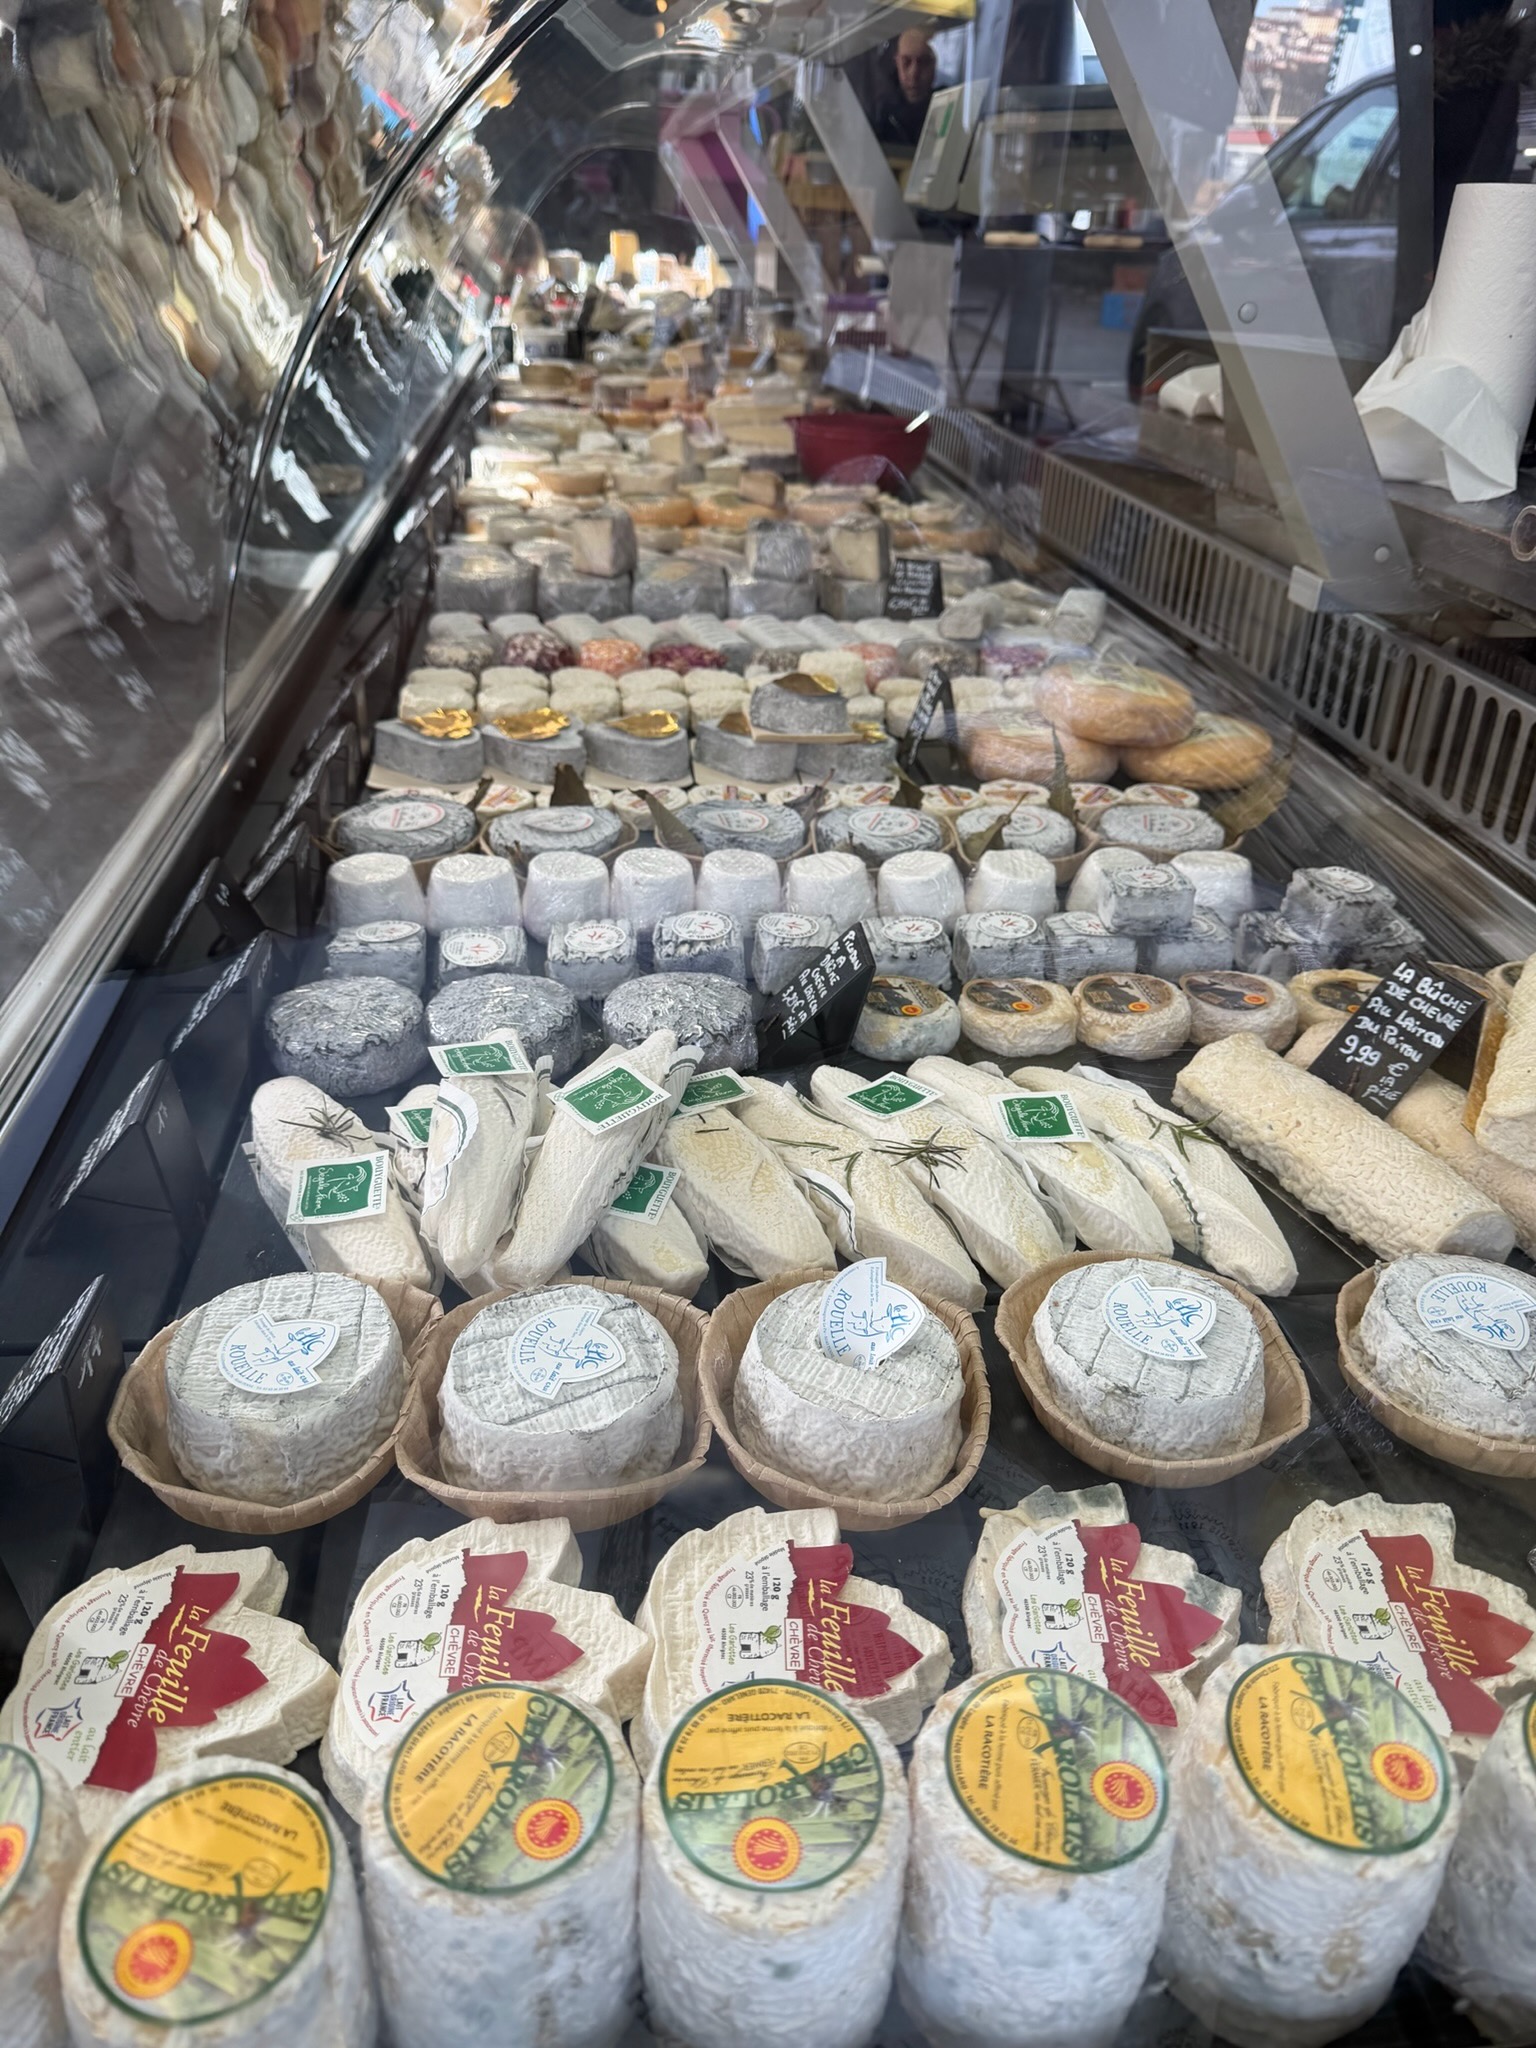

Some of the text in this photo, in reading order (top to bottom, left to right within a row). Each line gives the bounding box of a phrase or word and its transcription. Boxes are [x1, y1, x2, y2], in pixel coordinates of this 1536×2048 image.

[1384, 981, 1407, 999] DE
[1392, 962, 1473, 1015] LA BÛCHE
[1338, 1034, 1383, 1067] 9,99
[1431, 1281, 1488, 1303] ROUELLE
[520, 1318, 557, 1365] ROUELLE
[830, 1289, 852, 1357] ROUELLE
[1113, 1302, 1153, 1345] ROUELLE
[229, 1344, 268, 1384] ROUELLE
[1053, 1546, 1065, 1585] l'emballage
[1065, 1553, 1075, 1568] 120
[1349, 1557, 1369, 1595] l'emballage
[1361, 1563, 1373, 1578] 120
[424, 1578, 440, 1618] l'emballage
[440, 1584, 450, 1599] 120
[760, 1572, 770, 1612] l'emballage
[772, 1577, 781, 1592] 120
[119, 1596, 145, 1636] l'emballage
[140, 1601, 153, 1617] 120
[1087, 1595, 1105, 1641] CHÈVRE
[1110, 1557, 1161, 1668] la Feuille
[1394, 1604, 1421, 1649] CHÈVRE
[1405, 1566, 1479, 1675] la Feuille
[445, 1628, 461, 1674] CHÈVRE
[467, 1630, 480, 1647] de
[477, 1585, 516, 1684] la Feuill
[789, 1621, 803, 1668] CHÈVRE
[807, 1623, 819, 1641] de
[820, 1579, 857, 1692] la Feuille
[1105, 1599, 1129, 1672] de Chèvre
[1411, 1607, 1453, 1680] de Chèvre
[121, 1646, 149, 1695] CHÈVRE
[147, 1605, 212, 1723] la Feuille
[1043, 1654, 1051, 1668] FRAN
[127, 1649, 167, 1728] de Chèvre
[1258, 1695, 1267, 1711] LA
[466, 1714, 478, 1728] LA
[794, 1711, 810, 1722] LA
[984, 1715, 995, 1729] LA
